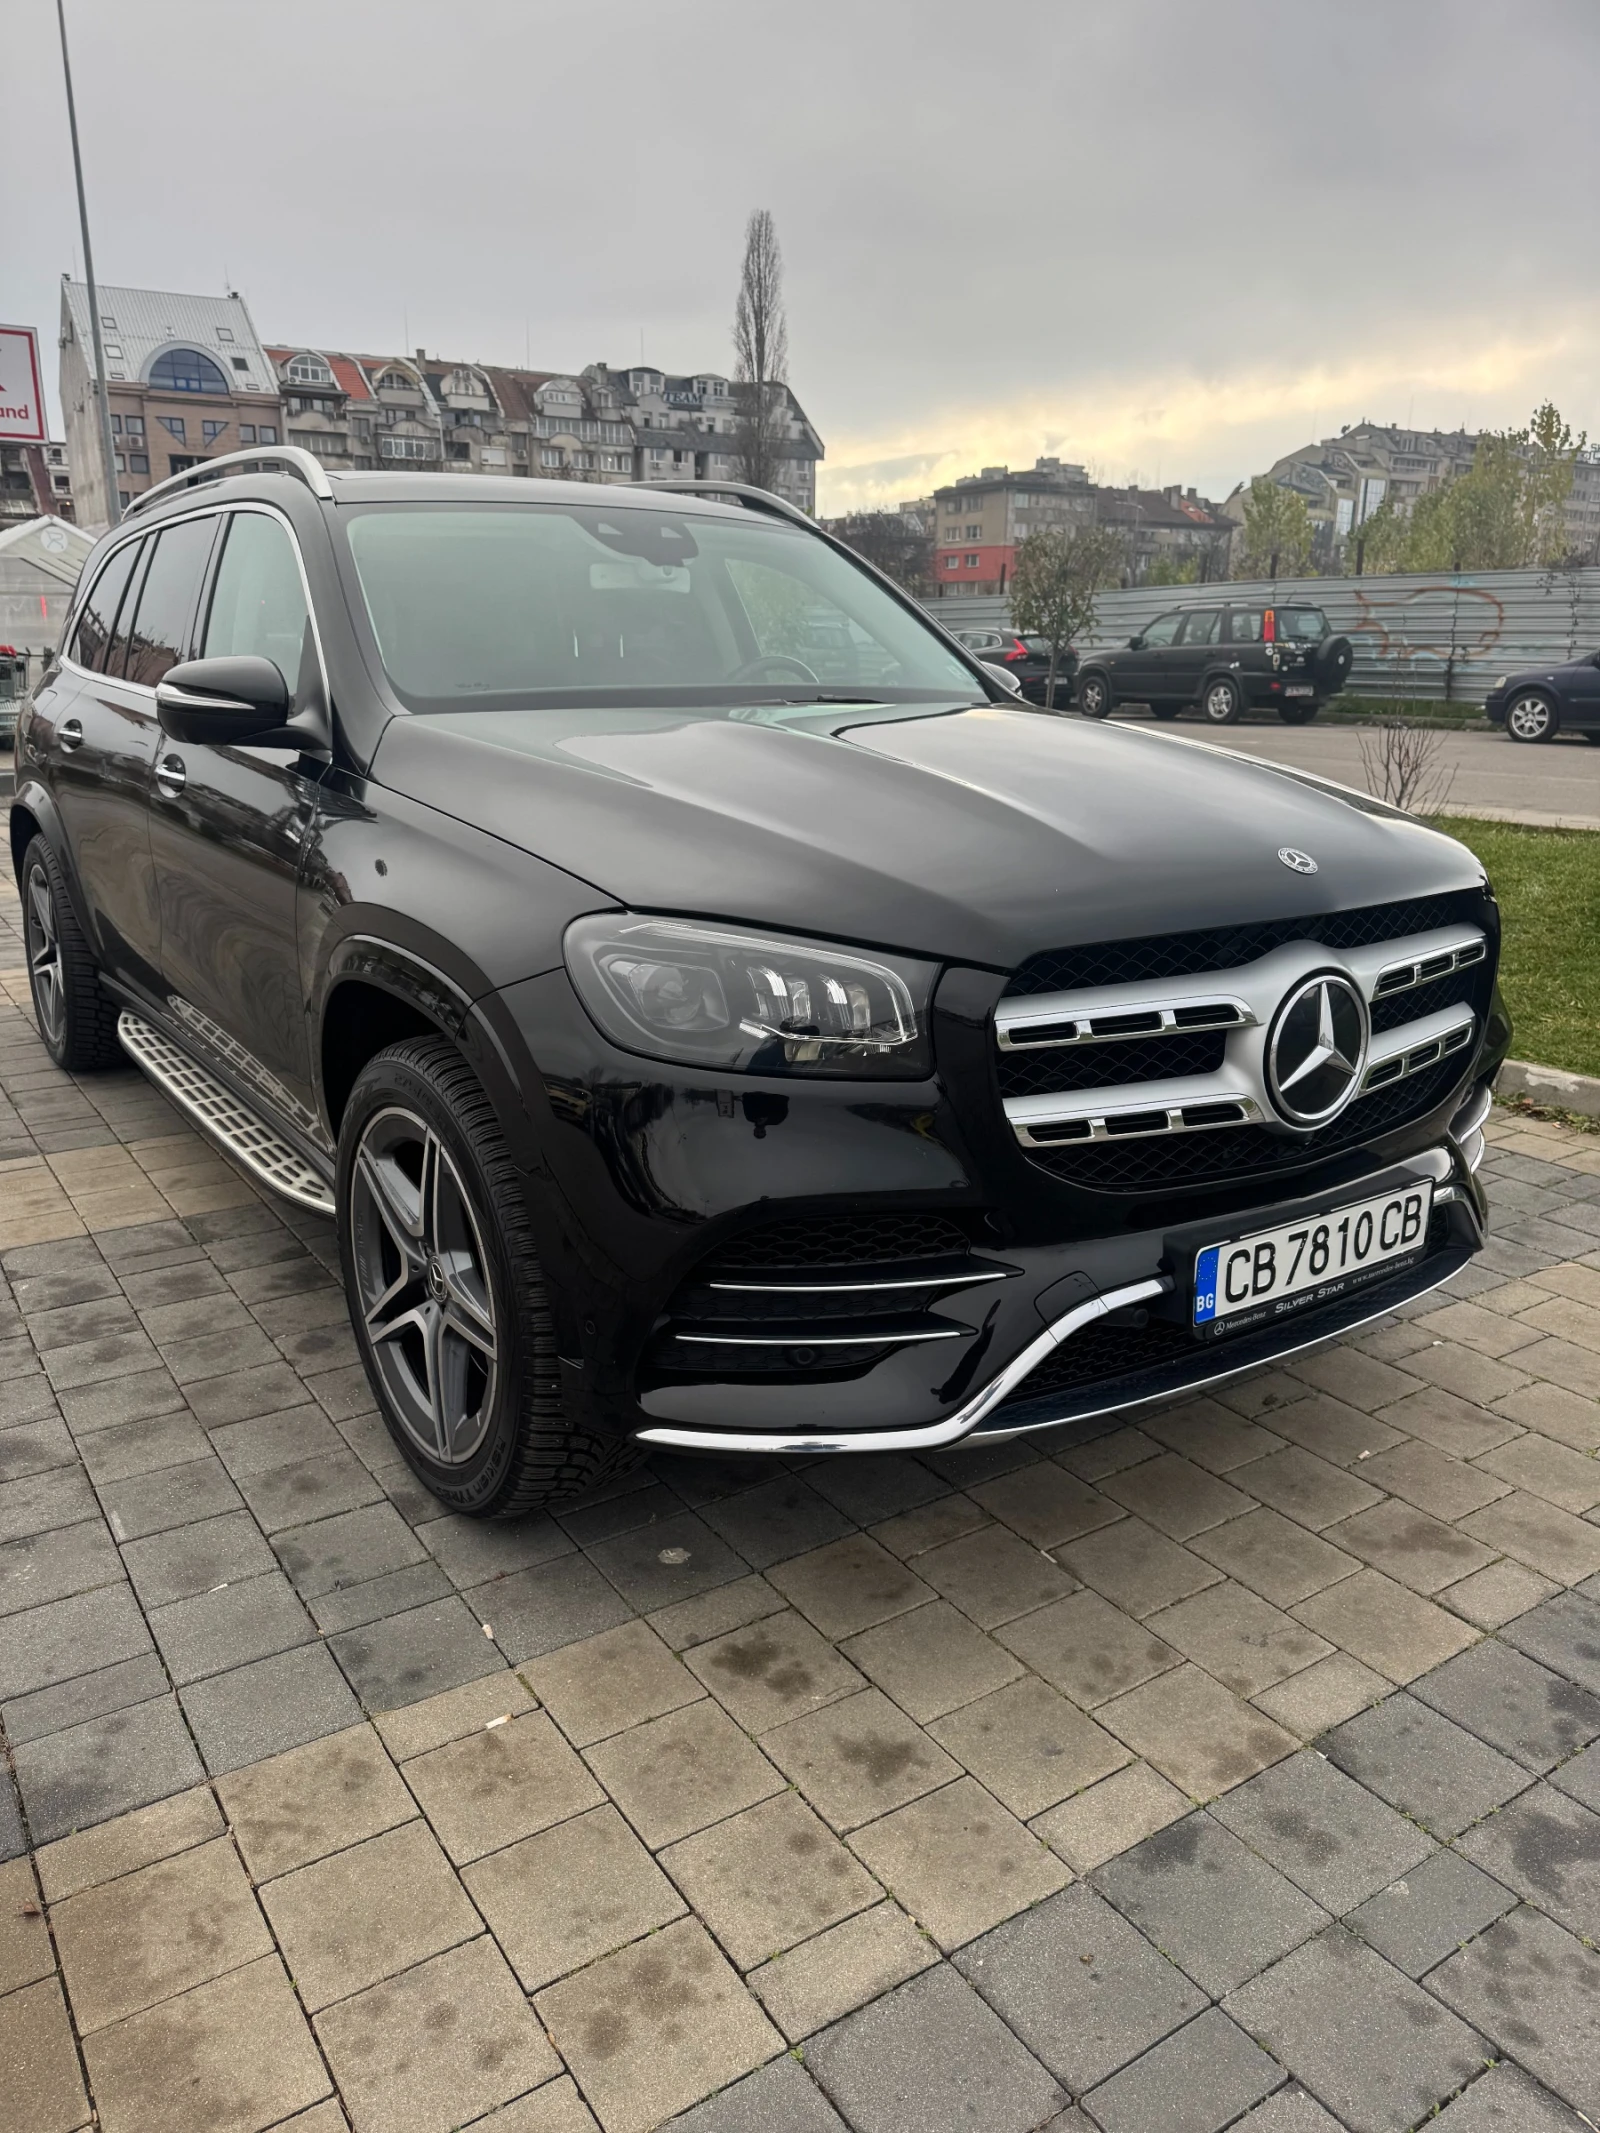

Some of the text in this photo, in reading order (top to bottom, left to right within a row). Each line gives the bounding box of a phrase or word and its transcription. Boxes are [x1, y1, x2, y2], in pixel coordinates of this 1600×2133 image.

[664, 392, 703, 404] TEAM
[1225, 1193, 1422, 1303] CB 7810 CB
[1196, 1293, 1214, 1312] BG
[1226, 1310, 1267, 1330] Mercedes-Benz
[1275, 1293, 1313, 1314] SILVER
[1317, 1282, 1344, 1299] STAR
